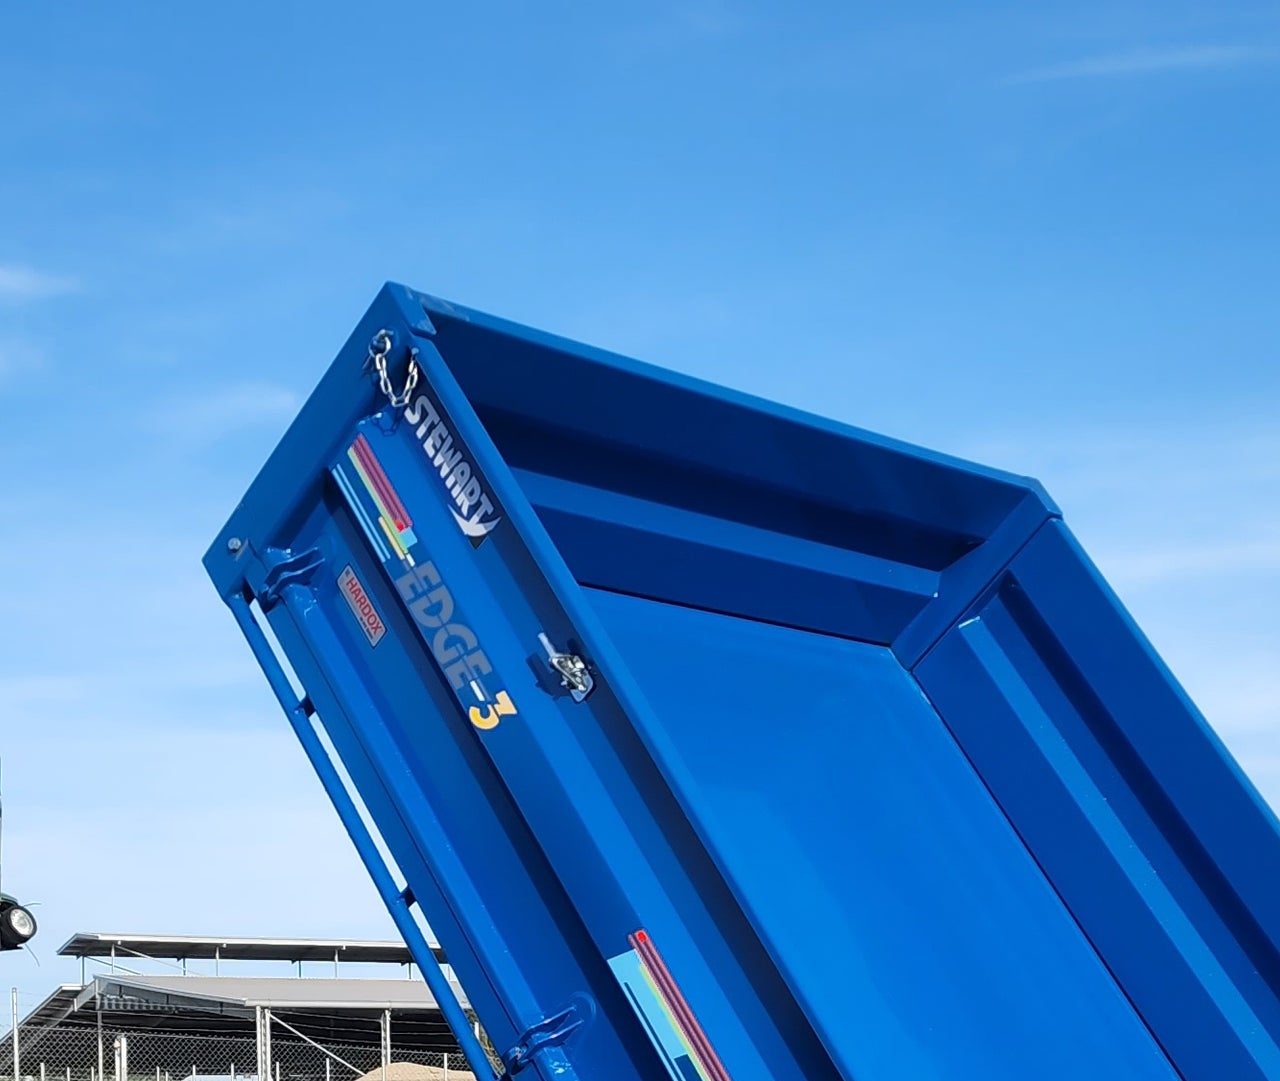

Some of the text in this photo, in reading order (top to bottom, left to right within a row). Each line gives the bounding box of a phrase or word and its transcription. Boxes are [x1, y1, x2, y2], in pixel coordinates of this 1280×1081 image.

[404, 395, 502, 538] STEWART
[346, 576, 382, 635] HARDOX
[395, 560, 518, 730] EDGE-3
